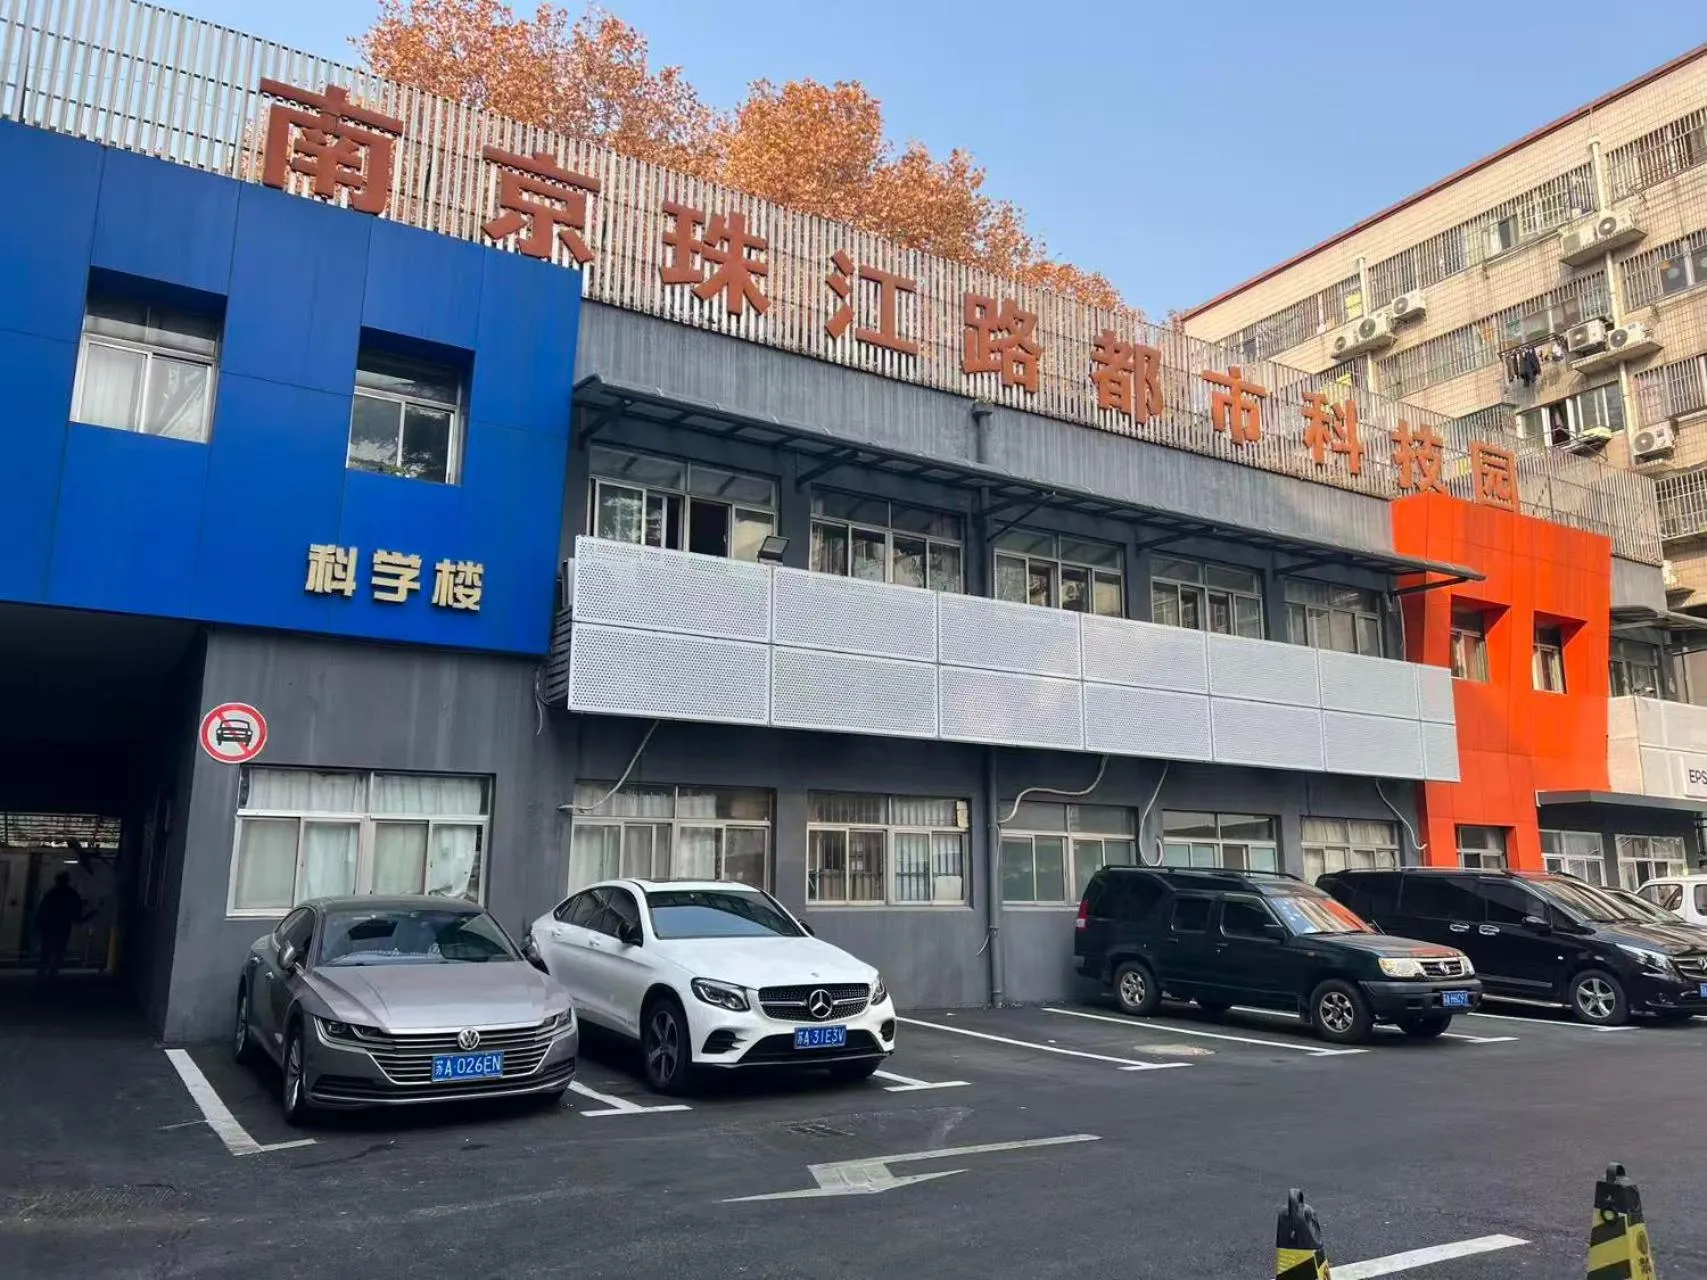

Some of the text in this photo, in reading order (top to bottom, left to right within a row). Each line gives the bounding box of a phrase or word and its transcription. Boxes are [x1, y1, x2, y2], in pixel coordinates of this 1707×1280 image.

[259, 76, 1519, 514] 南京珠江路都市科技园
[305, 543, 484, 611] 科学楼
